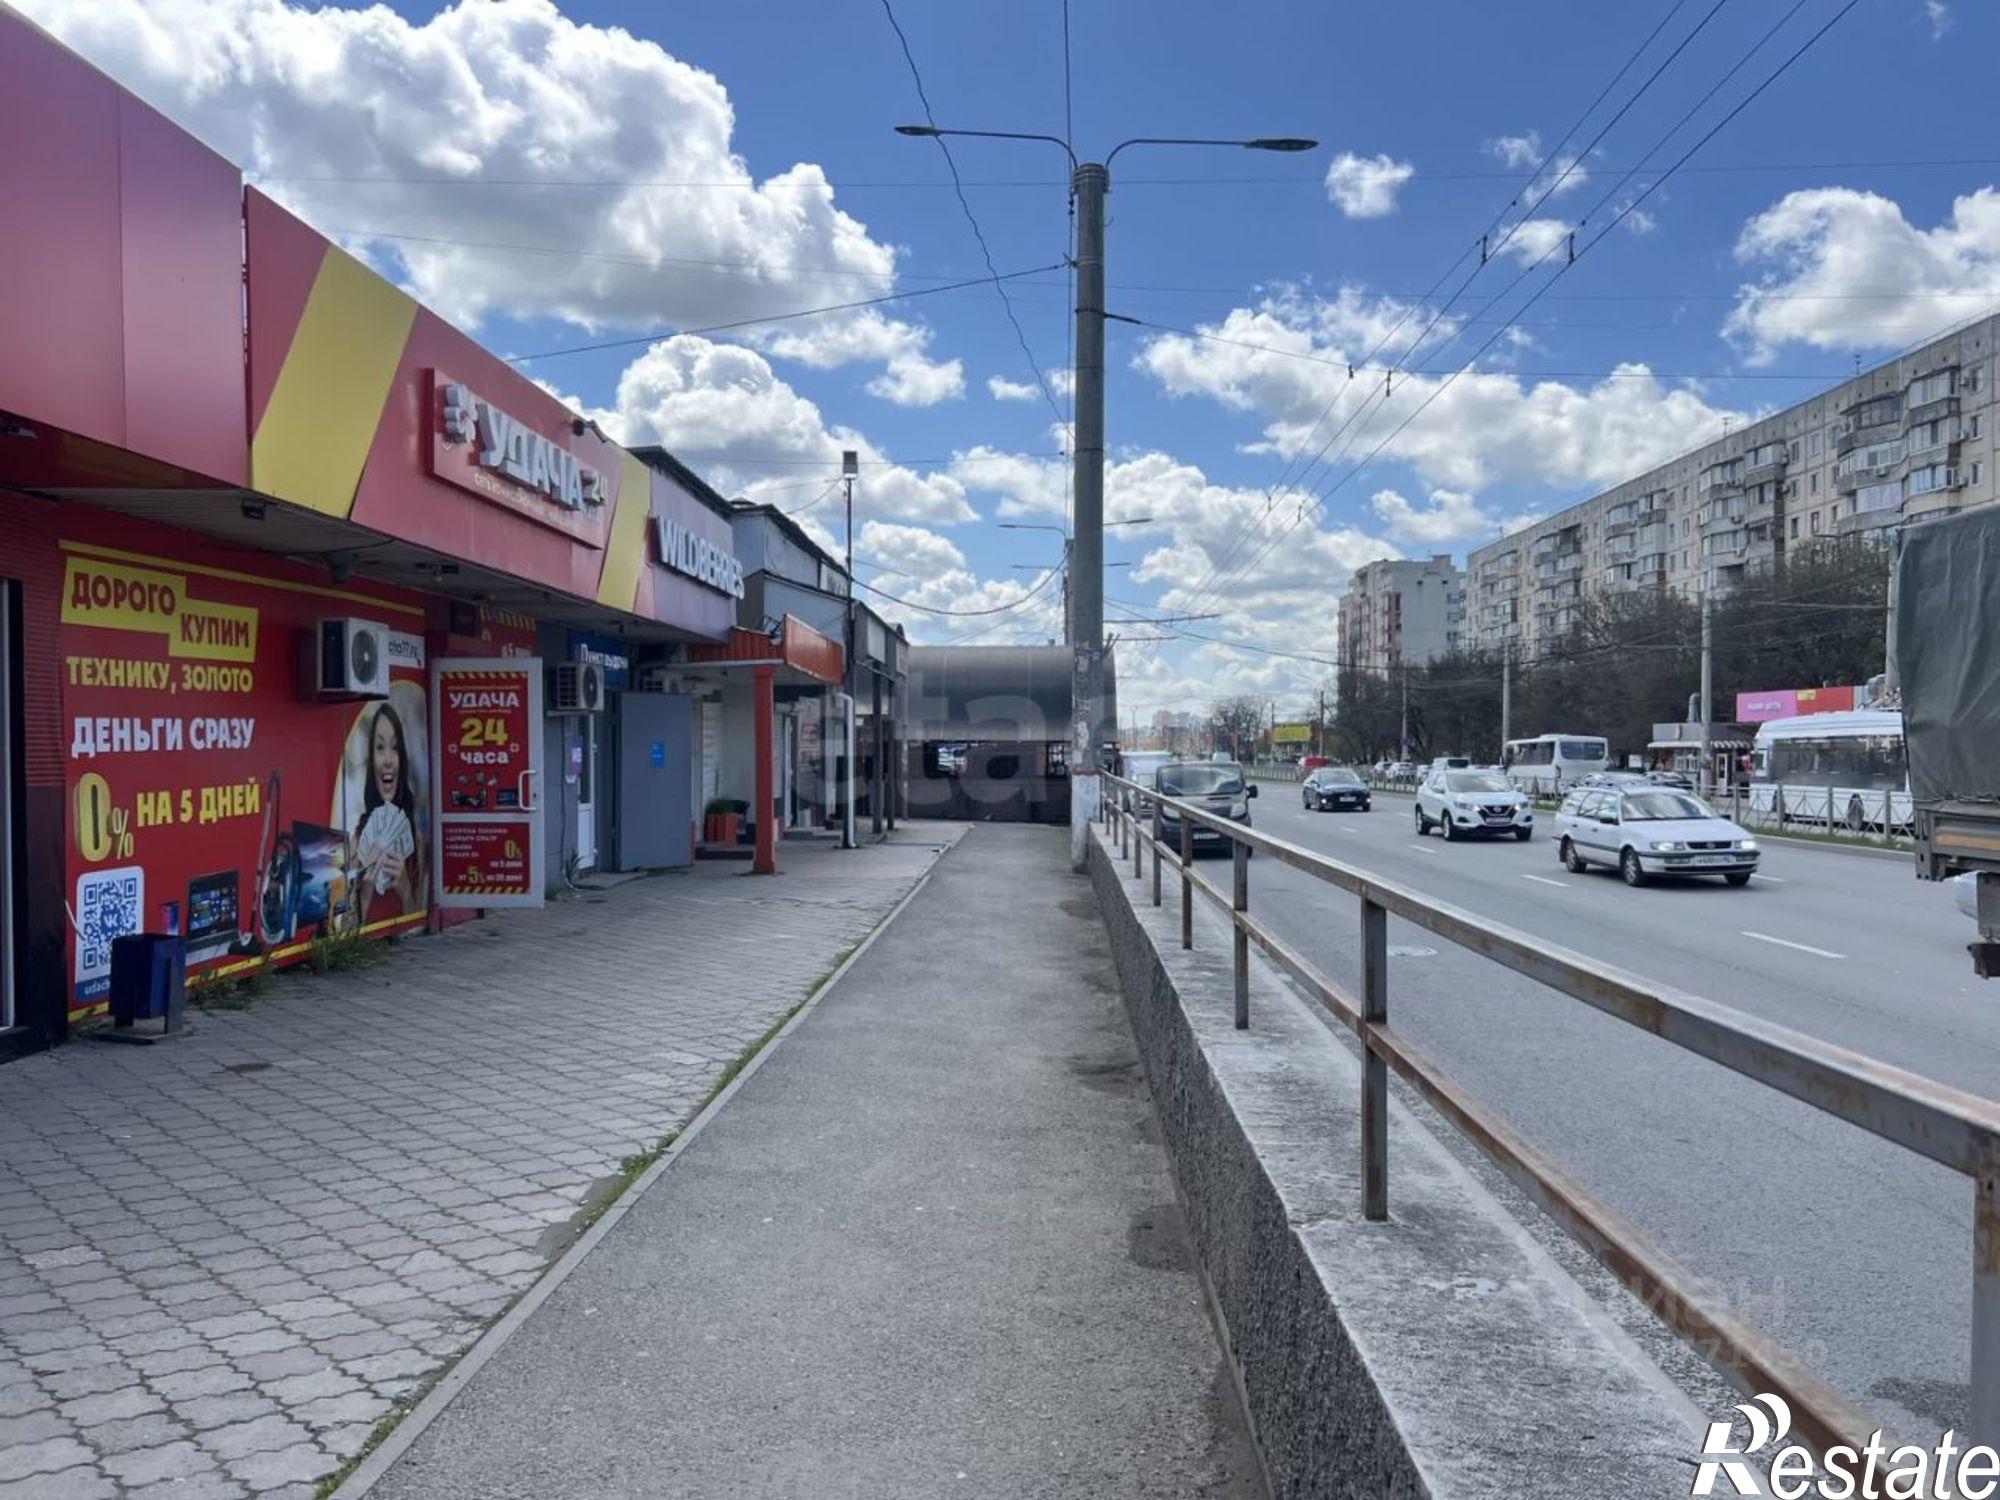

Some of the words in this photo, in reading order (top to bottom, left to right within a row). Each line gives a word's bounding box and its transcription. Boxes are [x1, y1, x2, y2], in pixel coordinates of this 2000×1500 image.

[477, 403, 586, 512] УДАЧА
[659, 514, 745, 600] WILDBERRIES
[71, 571, 176, 615] ДОРОГО
[180, 613, 249, 648] КУПИМ
[66, 656, 178, 694] ТЕХНИКУ,
[182, 663, 254, 693] ЗОЛОТО
[449, 691, 519, 709] УДАЧА
[71, 717, 184, 759] ДЕНЬГИ
[189, 717, 255, 750] СРАЗУ
[460, 718, 508, 747] 24
[460, 751, 509, 764] часа
[136, 791, 173, 827] НА
[179, 789, 194, 823] 5
[199, 777, 260, 824] ДНЕЙ
